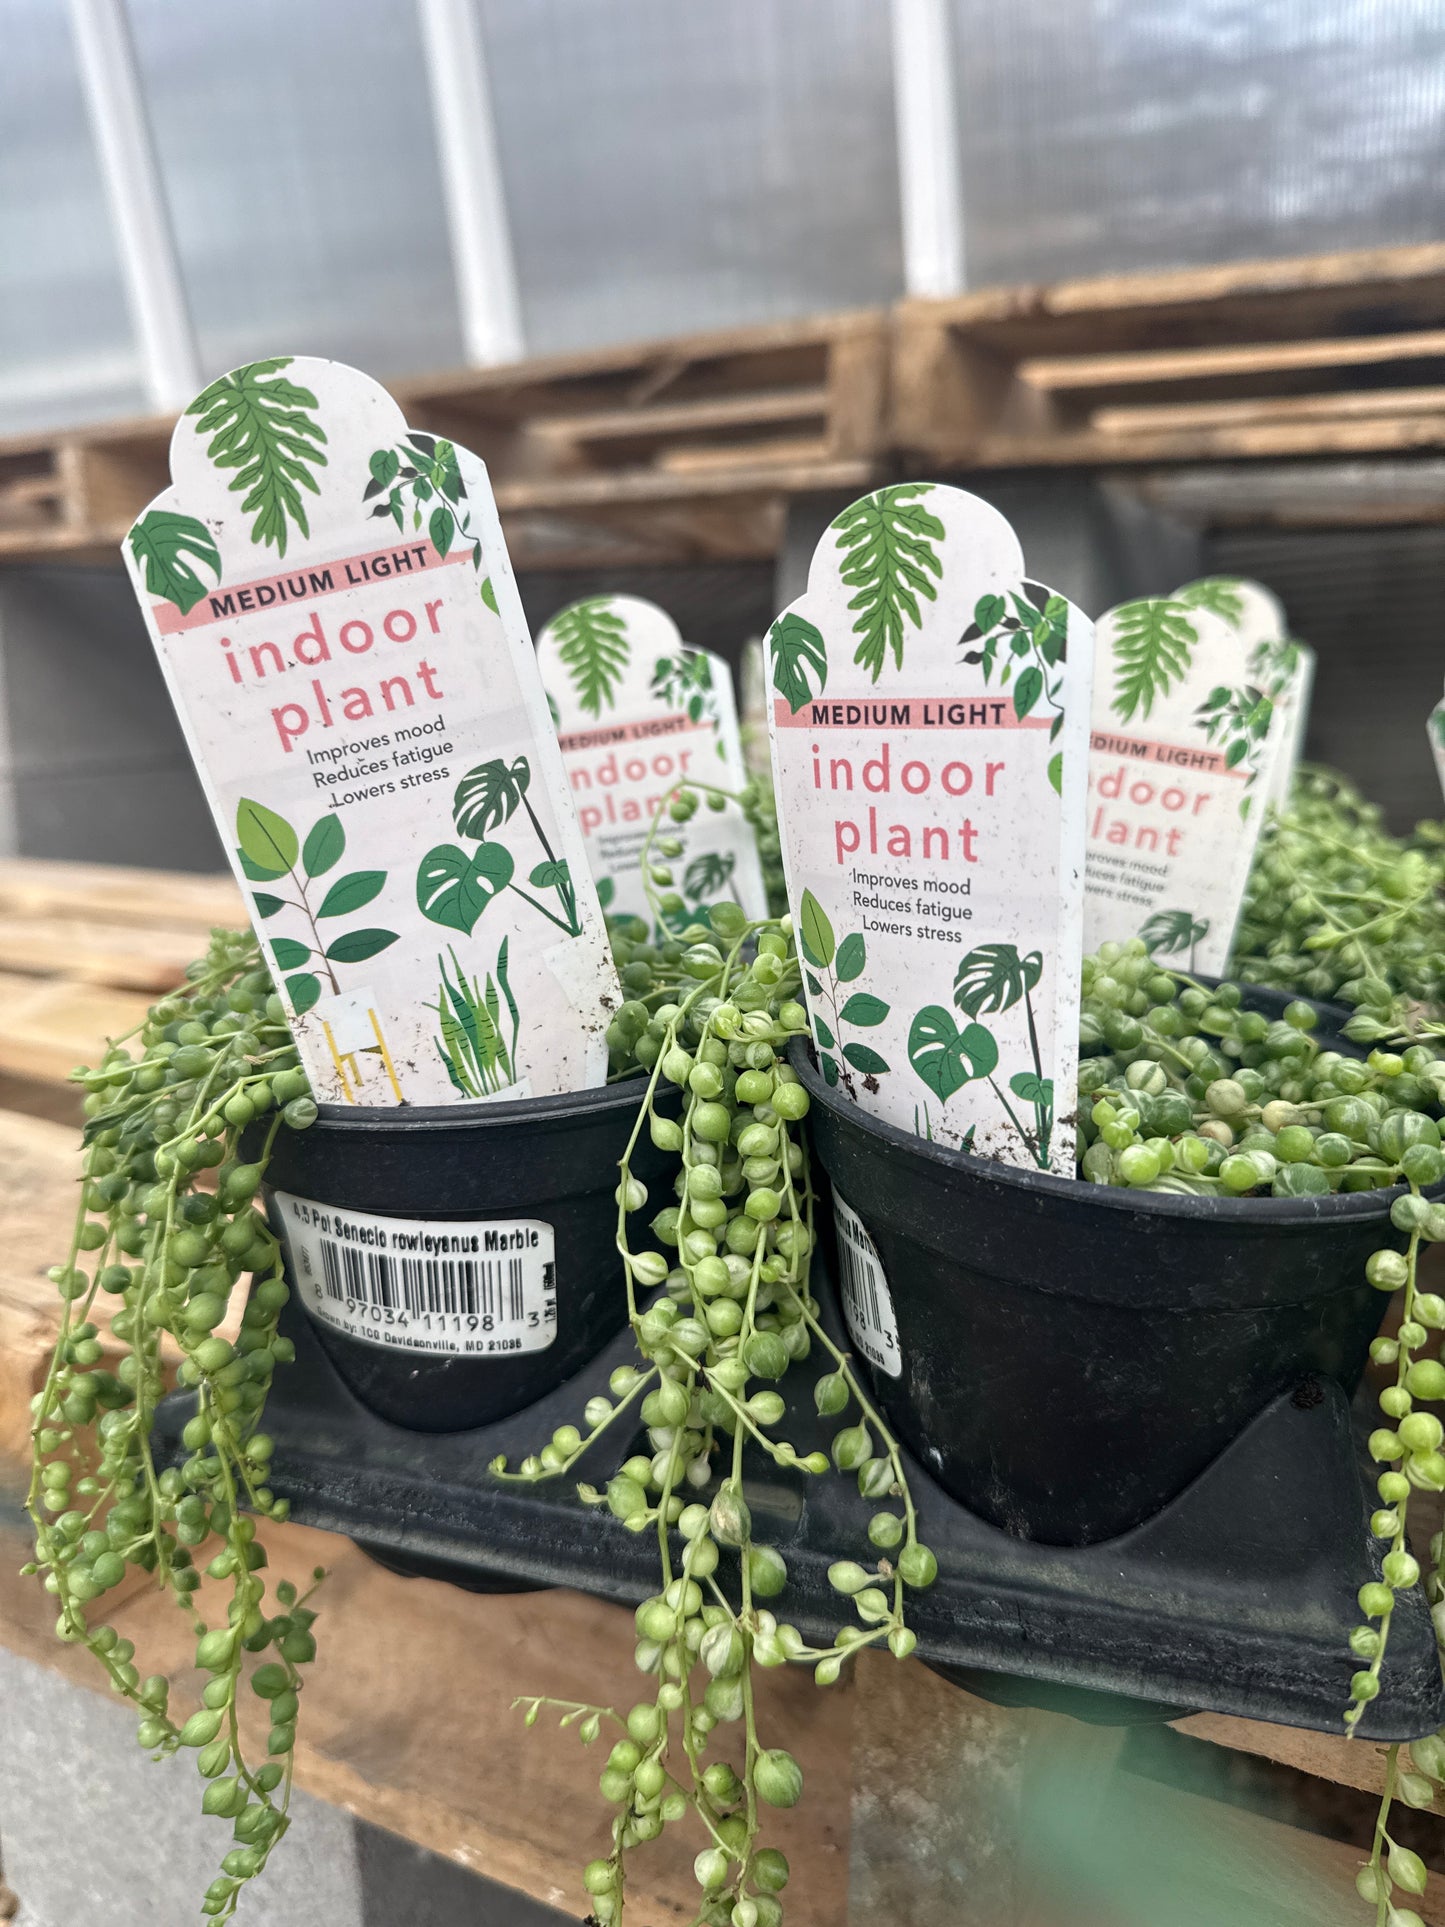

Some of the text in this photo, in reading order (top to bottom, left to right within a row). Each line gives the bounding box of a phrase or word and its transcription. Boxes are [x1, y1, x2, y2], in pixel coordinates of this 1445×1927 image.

[209, 546, 429, 619] MEDIUM LIGHT
[219, 599, 445, 686] indoor
[270, 660, 445, 753] plant
[812, 703, 1007, 726] MEDIUM LIGHT
[307, 714, 446, 765] Improves mood
[632, 718, 686, 739] LIGHT
[313, 742, 454, 788] Reduces fatigue
[569, 749, 693, 791] ndoor
[811, 743, 1005, 797] indoor
[1090, 735, 1219, 771] DIUM LIGHT
[330, 767, 450, 808] Lowers stress
[1088, 766, 1211, 816] door
[578, 789, 681, 837] plan
[1091, 806, 1183, 857] lant
[834, 806, 979, 865] plant
[852, 868, 971, 895] Improves mood
[1128, 861, 1168, 877] mood
[853, 891, 973, 922] Reduces fatigue
[863, 914, 962, 943] Lowers stress
[392, 1230, 479, 1257] rowleyanus
[484, 1228, 540, 1251] Marble
[346, 1298, 409, 1328] 97034
[423, 1313, 495, 1331] 11198
[527, 1311, 541, 1328] 3
[465, 1340, 484, 1351] MD
